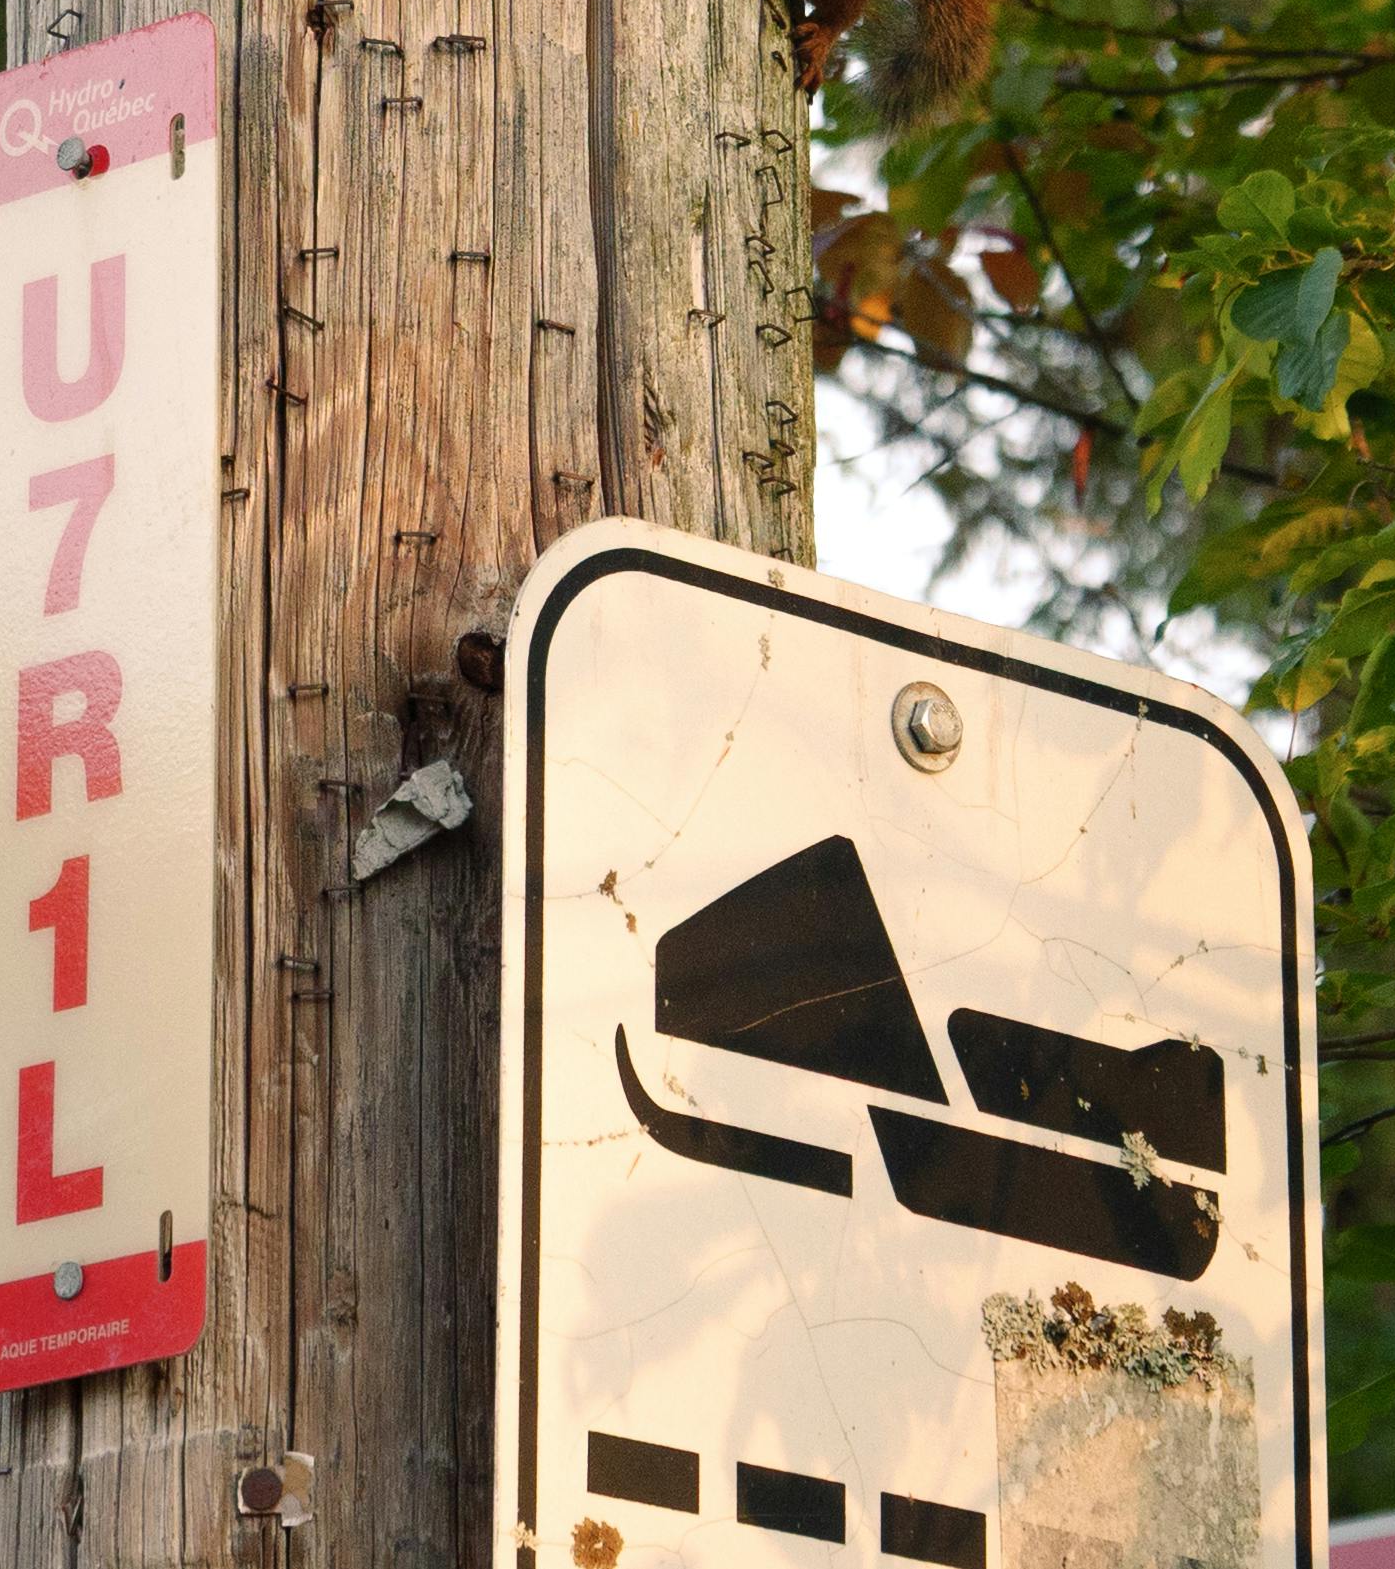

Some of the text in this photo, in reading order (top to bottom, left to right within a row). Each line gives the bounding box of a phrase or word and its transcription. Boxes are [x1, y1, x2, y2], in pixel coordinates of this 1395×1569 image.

[48, 79, 114, 117] Hydro
[72, 92, 156, 134] Québec
[16, 253, 126, 1226] U7R1L
[40, 1318, 130, 1352] TEMPORAIRE
